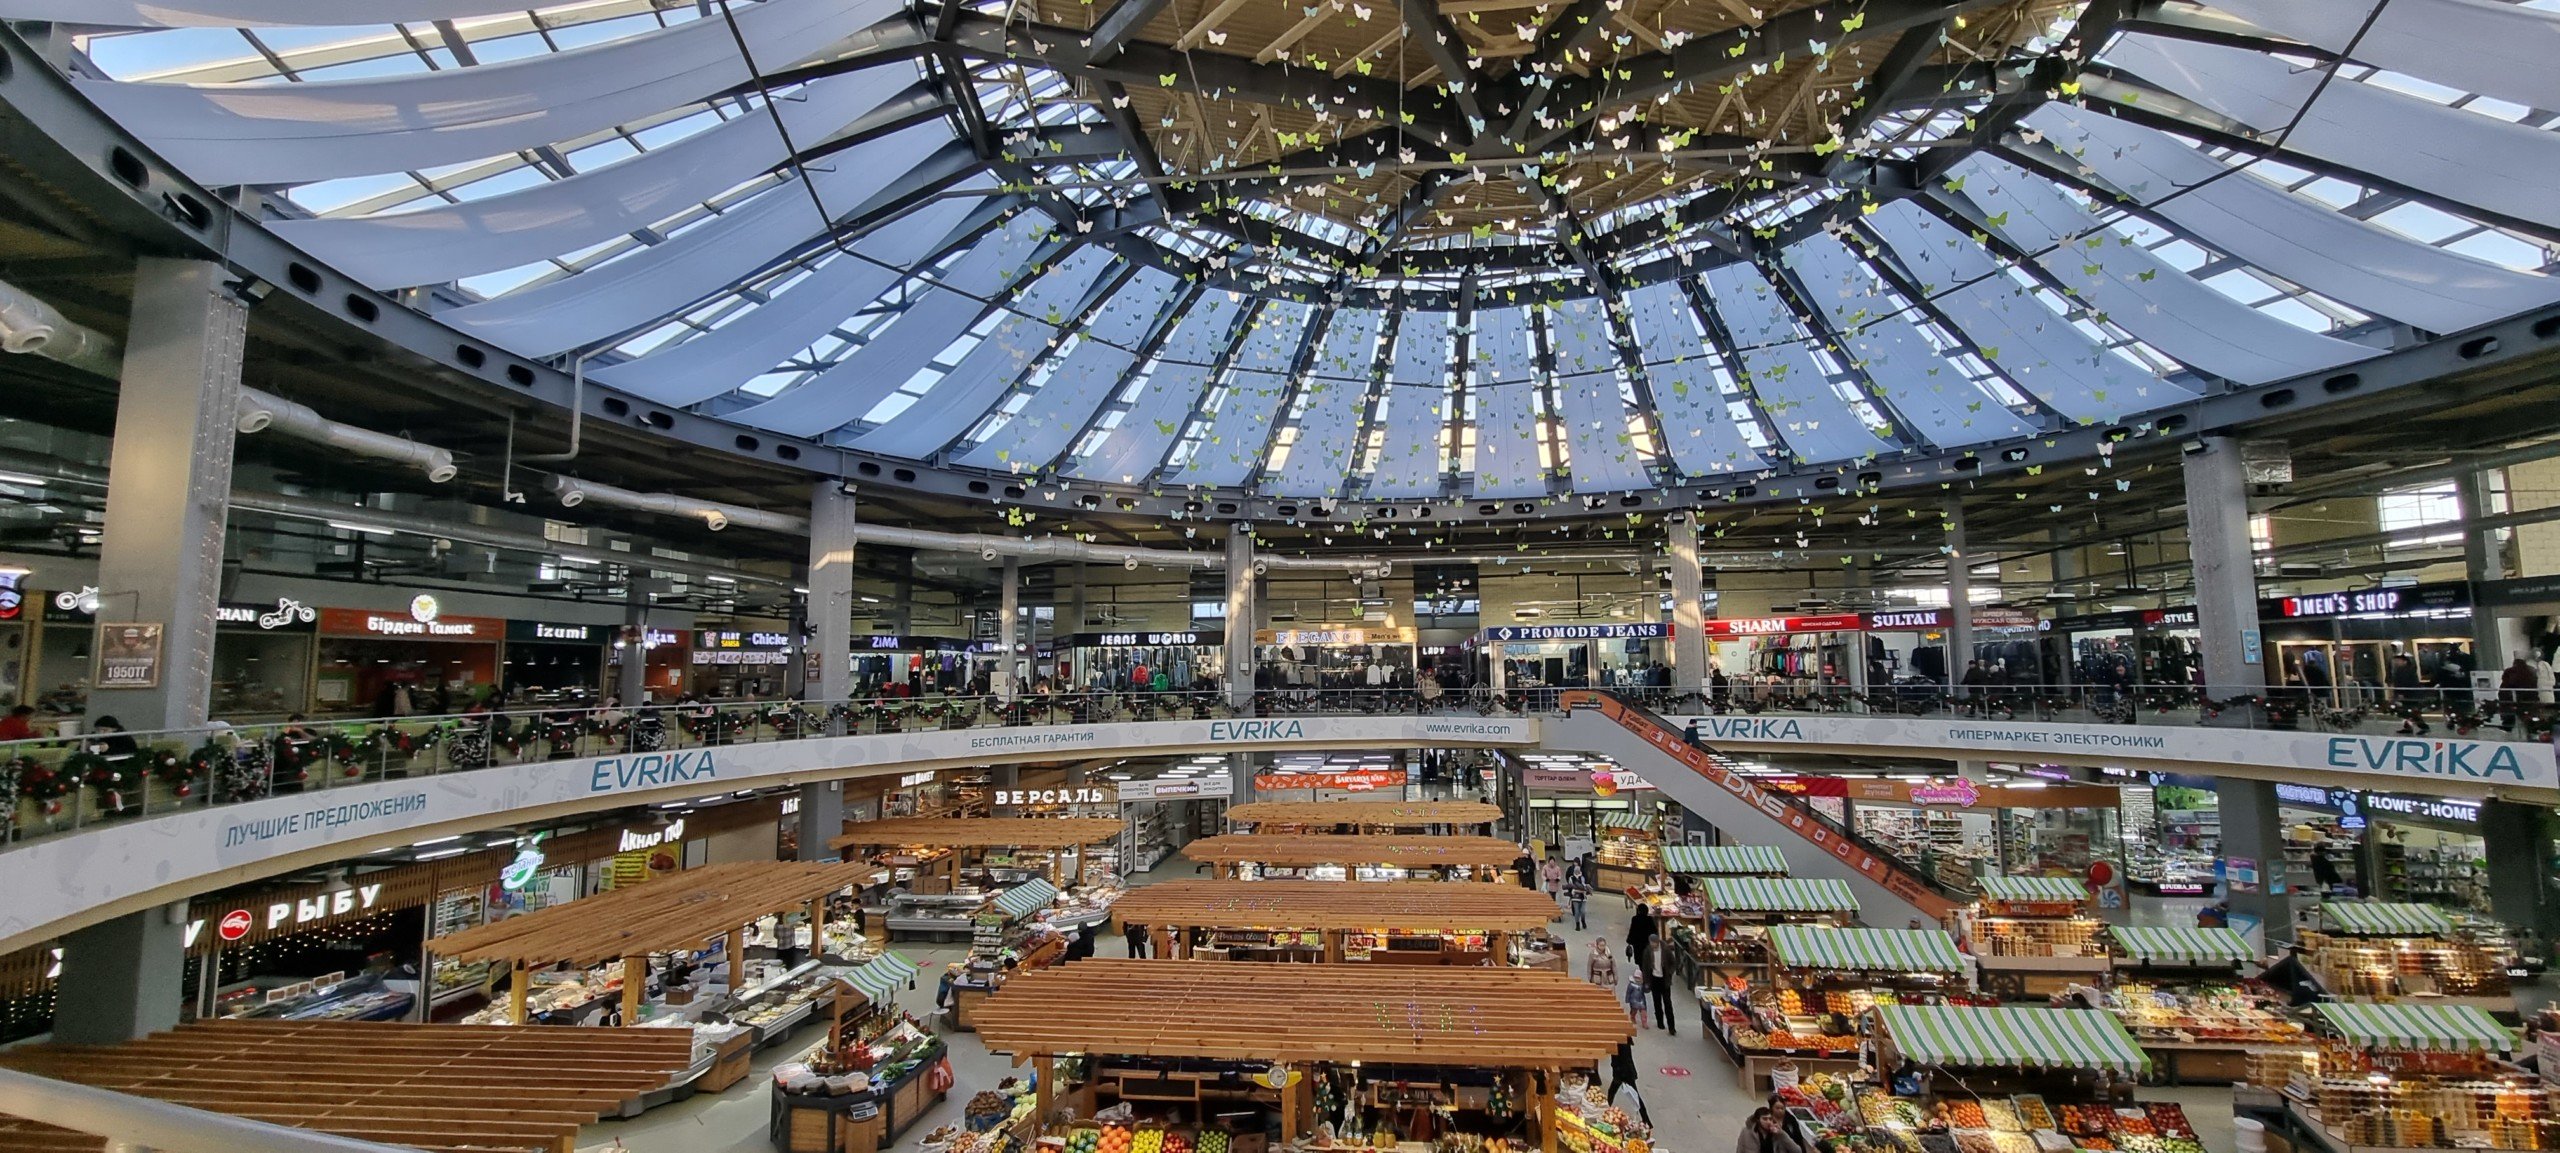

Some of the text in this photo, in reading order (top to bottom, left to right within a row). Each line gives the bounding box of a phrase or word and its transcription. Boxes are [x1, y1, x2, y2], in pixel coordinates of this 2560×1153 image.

[2303, 592, 2398, 615] MEN'S SHOP
[368, 617, 423, 635] Бірден
[1729, 619, 1786, 633] SHARM
[1872, 612, 1937, 628] SULTAN
[2164, 612, 2195, 624] STYLE
[536, 623, 587, 640] izumi
[1100, 633, 1197, 646] JEANS WORLD
[1520, 624, 1658, 639] PROMODE JEANS
[1422, 646, 1445, 655] LADY
[1426, 723, 1511, 735] www.evrika.com
[971, 732, 1094, 748] БЕСПЛАТНАЯ ГАРАНТИЯ
[1949, 729, 2164, 748] ГИПЕРМАРКЕТ ЭЛЕКТРОНИКИ
[995, 789, 1103, 805] ВЕРСАЛЬ
[1156, 785, 1198, 794] ВЫПЕЧКИН
[1723, 770, 1786, 817] DNS
[2368, 795, 2477, 822] FLOWES HOME
[225, 793, 426, 847] ЛУЧШИЕ ПРЕДЛОЖЕНИЯ
[664, 819, 684, 843] ПФ
[267, 883, 381, 929] РЫБУ
